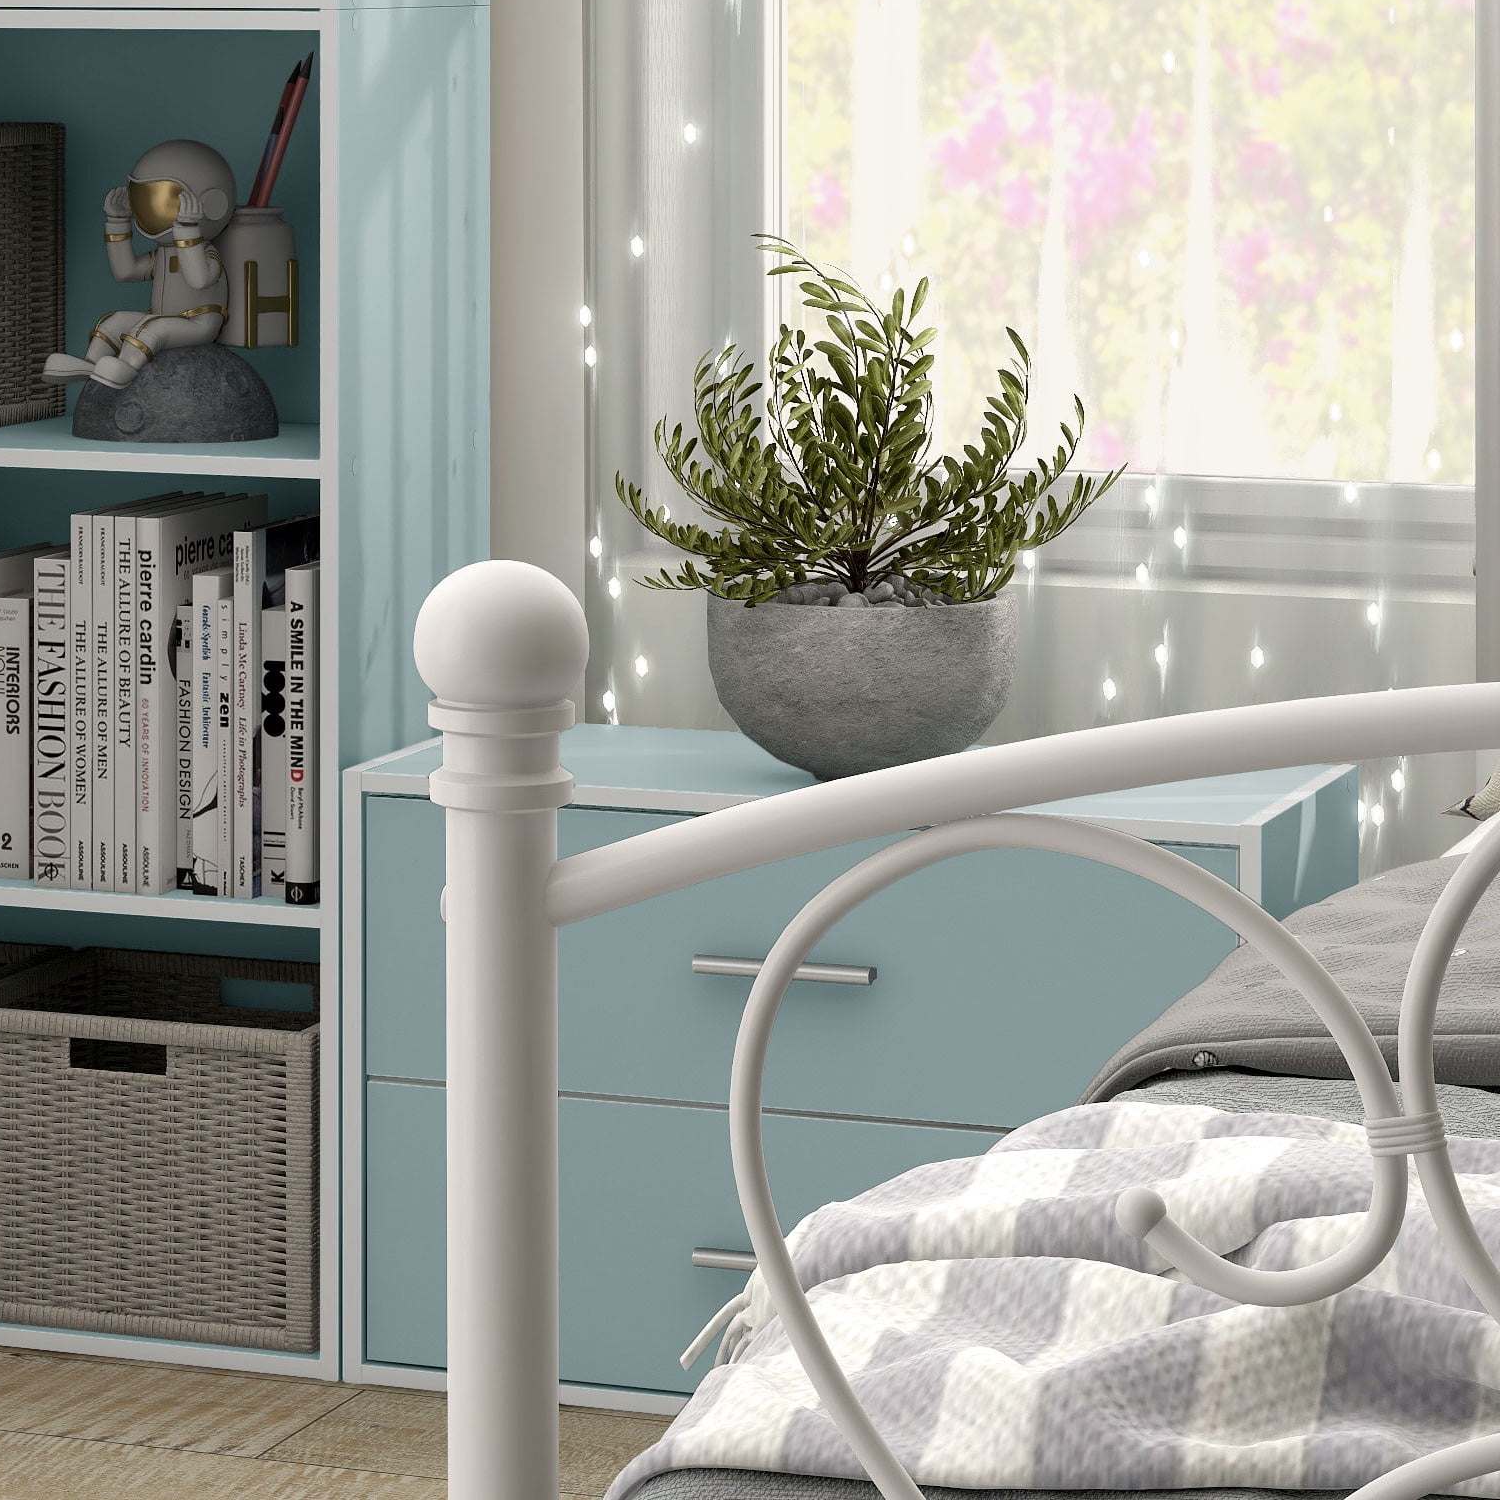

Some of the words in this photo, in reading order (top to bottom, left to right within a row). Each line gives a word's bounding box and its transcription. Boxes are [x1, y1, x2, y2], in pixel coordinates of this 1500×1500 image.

[119, 538, 132, 575] THE
[176, 536, 215, 575] pierre
[37, 564, 66, 632] THE
[138, 549, 155, 612] pierre
[119, 578, 132, 646] ALLURE
[291, 600, 303, 613] A
[75, 620, 87, 653] THE
[97, 621, 108, 653] THE
[139, 619, 156, 685] cardin
[238, 622, 247, 651] Linda
[291, 618, 303, 670] SMILE
[119, 649, 132, 672] OF
[6, 647, 20, 735] INTERIORS
[75, 656, 87, 717] ALLURE
[97, 657, 108, 717] ALLURE
[201, 672, 211, 703] Fantastic
[291, 676, 303, 693] IN
[37, 639, 67, 781] FASHION
[119, 677, 132, 748] BEAUTY
[141, 711, 149, 740] YEARS
[179, 679, 191, 751] FASHION
[201, 706, 211, 749] Architecture
[219, 692, 229, 728] zen
[238, 716, 247, 735] Life
[291, 699, 303, 730] THE
[75, 720, 87, 741] OF
[97, 720, 108, 741] OF
[141, 743, 149, 755] OF
[238, 737, 247, 747] in
[75, 744, 87, 805] WOMEN
[97, 744, 108, 780] MEN
[237, 749, 247, 808] Photographs
[291, 735, 304, 782] MIND
[141, 757, 149, 812] INNOVATION
[179, 758, 191, 819] DESIGN
[1, 832, 12, 850] 2
[37, 790, 66, 882] BOOK
[142, 846, 150, 887] ASSOULINE
